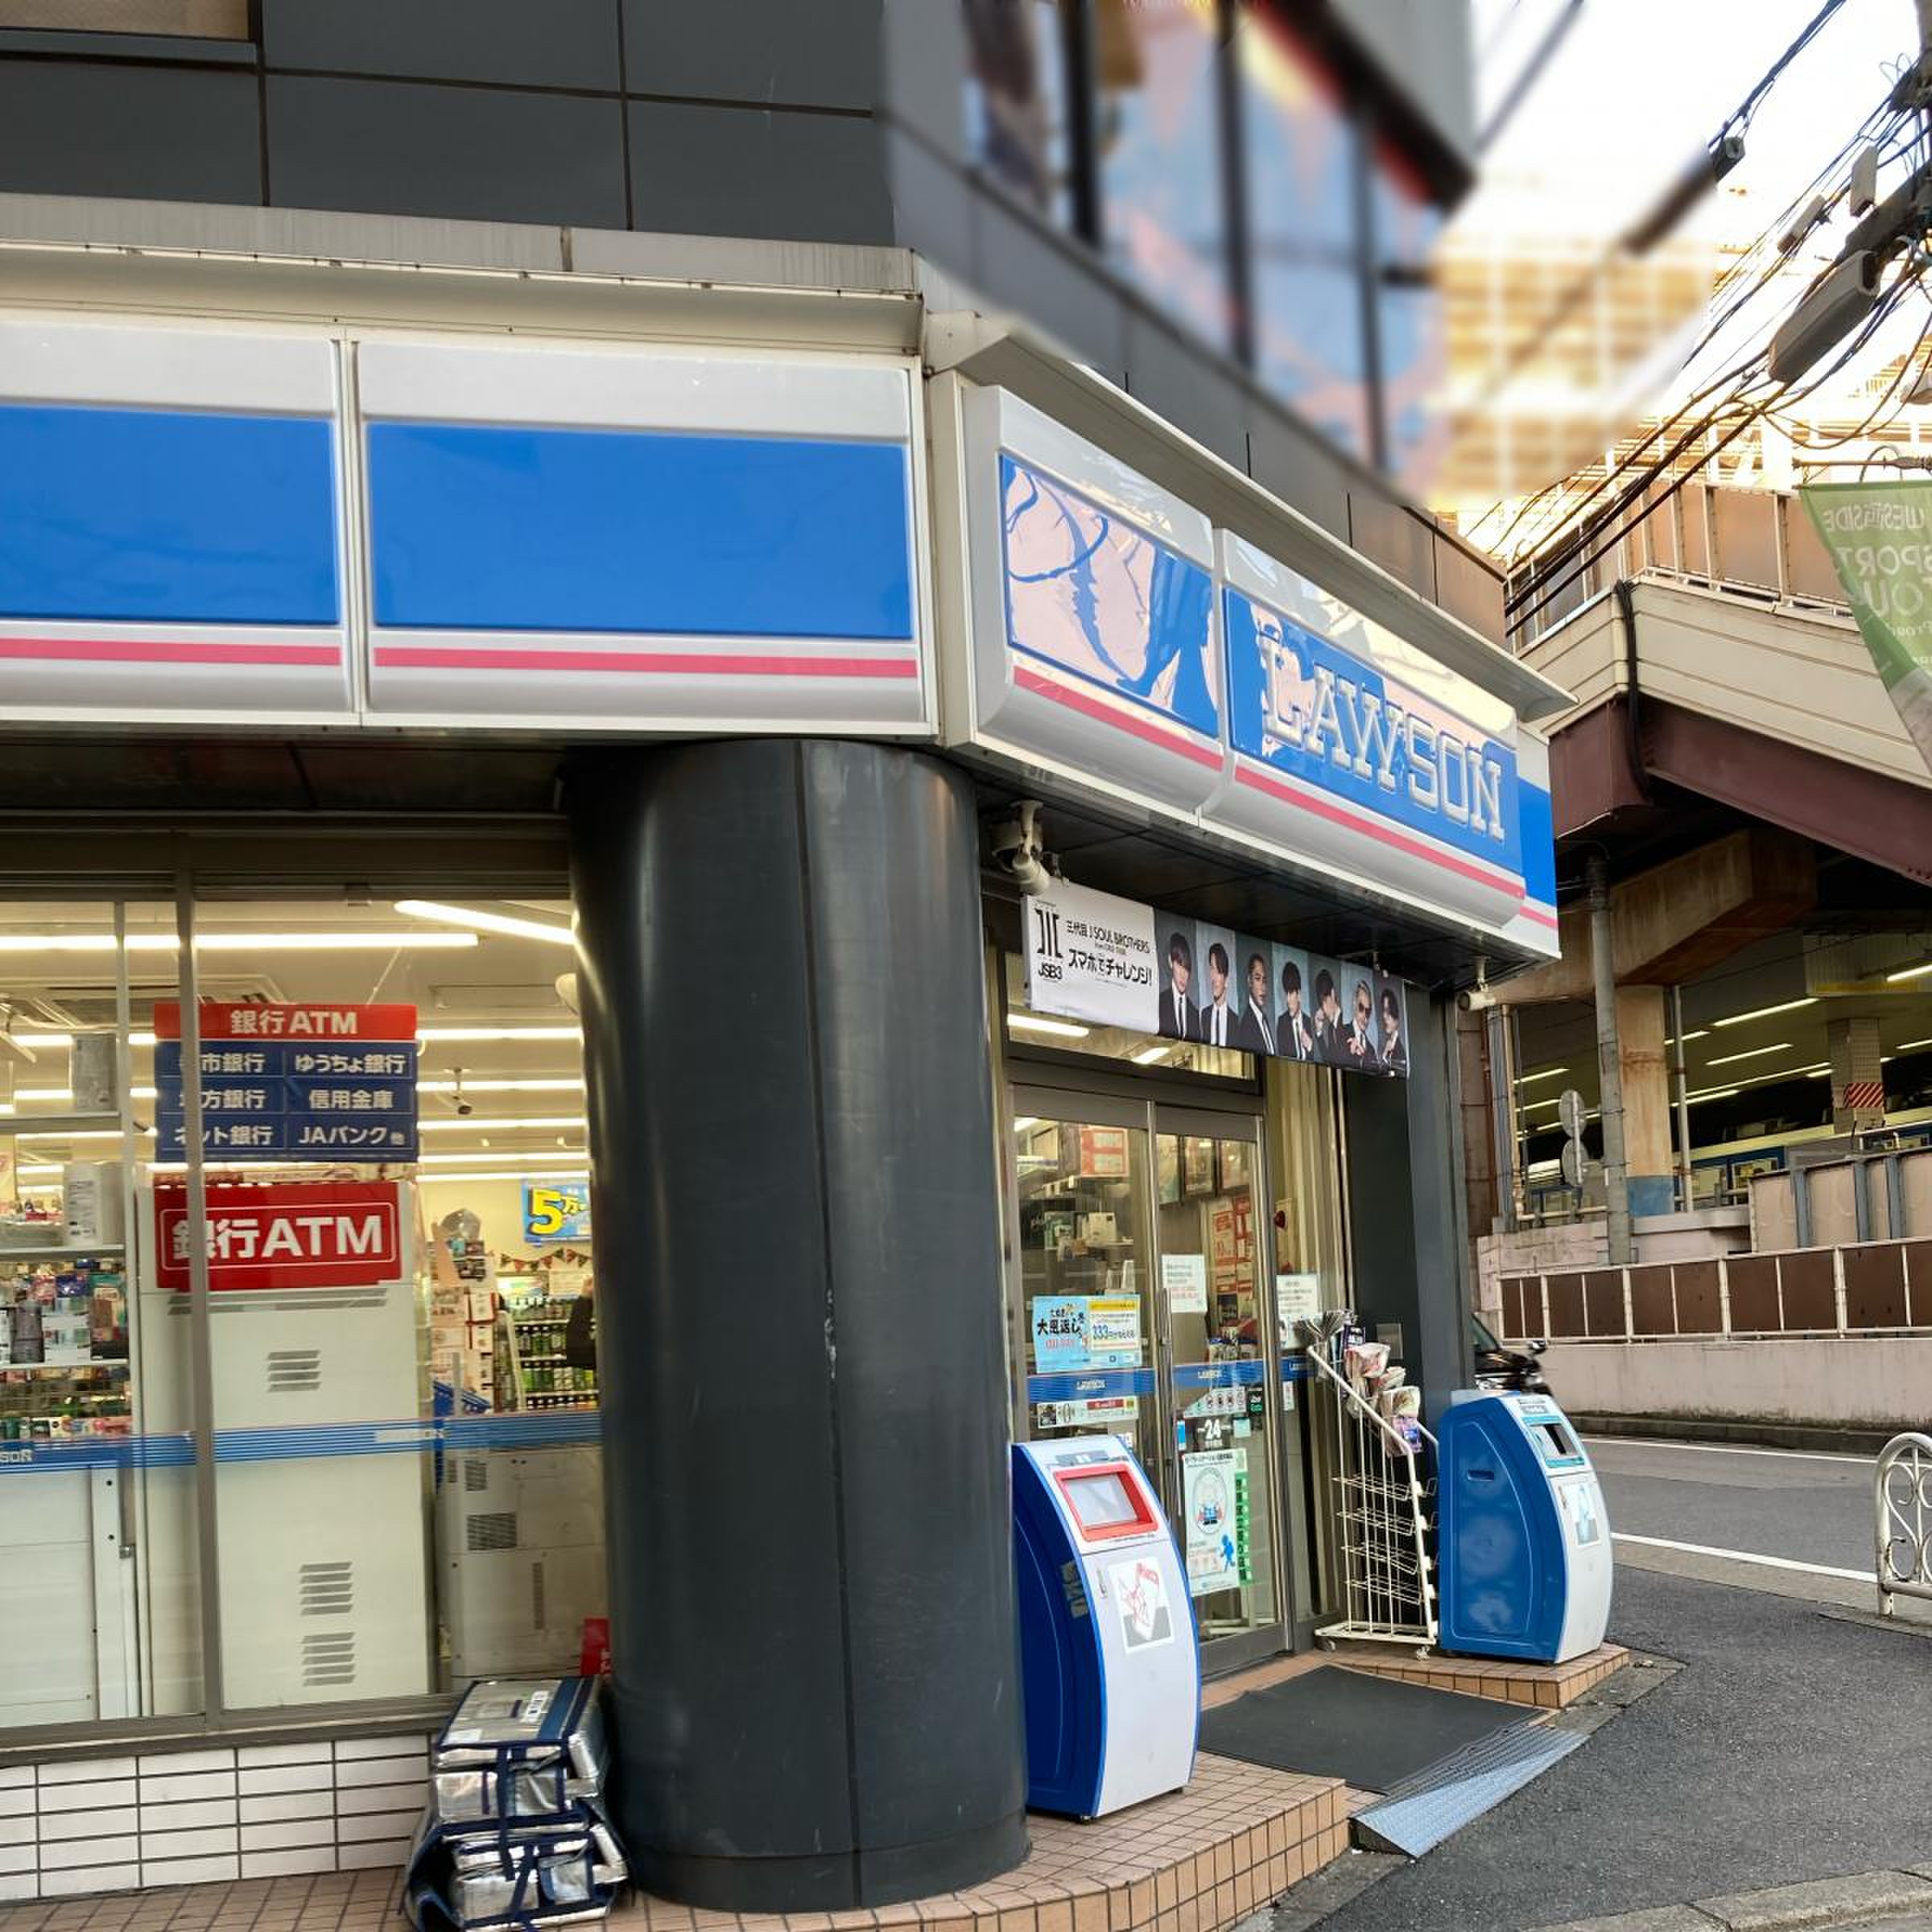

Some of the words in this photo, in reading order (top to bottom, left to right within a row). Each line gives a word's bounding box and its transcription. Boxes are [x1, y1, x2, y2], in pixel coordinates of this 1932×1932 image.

[1261, 634, 1505, 840] LAWSON
[232, 1009, 357, 1034] 銀行ATM
[179, 1053, 265, 1073] 市銀行
[295, 1054, 406, 1075] ゆうちょ銀行
[179, 1089, 266, 1109] 方銀行
[309, 1089, 394, 1109] 信用金庫
[299, 1126, 387, 1145] JAバンク
[1205, 1418, 1221, 1439] 24
